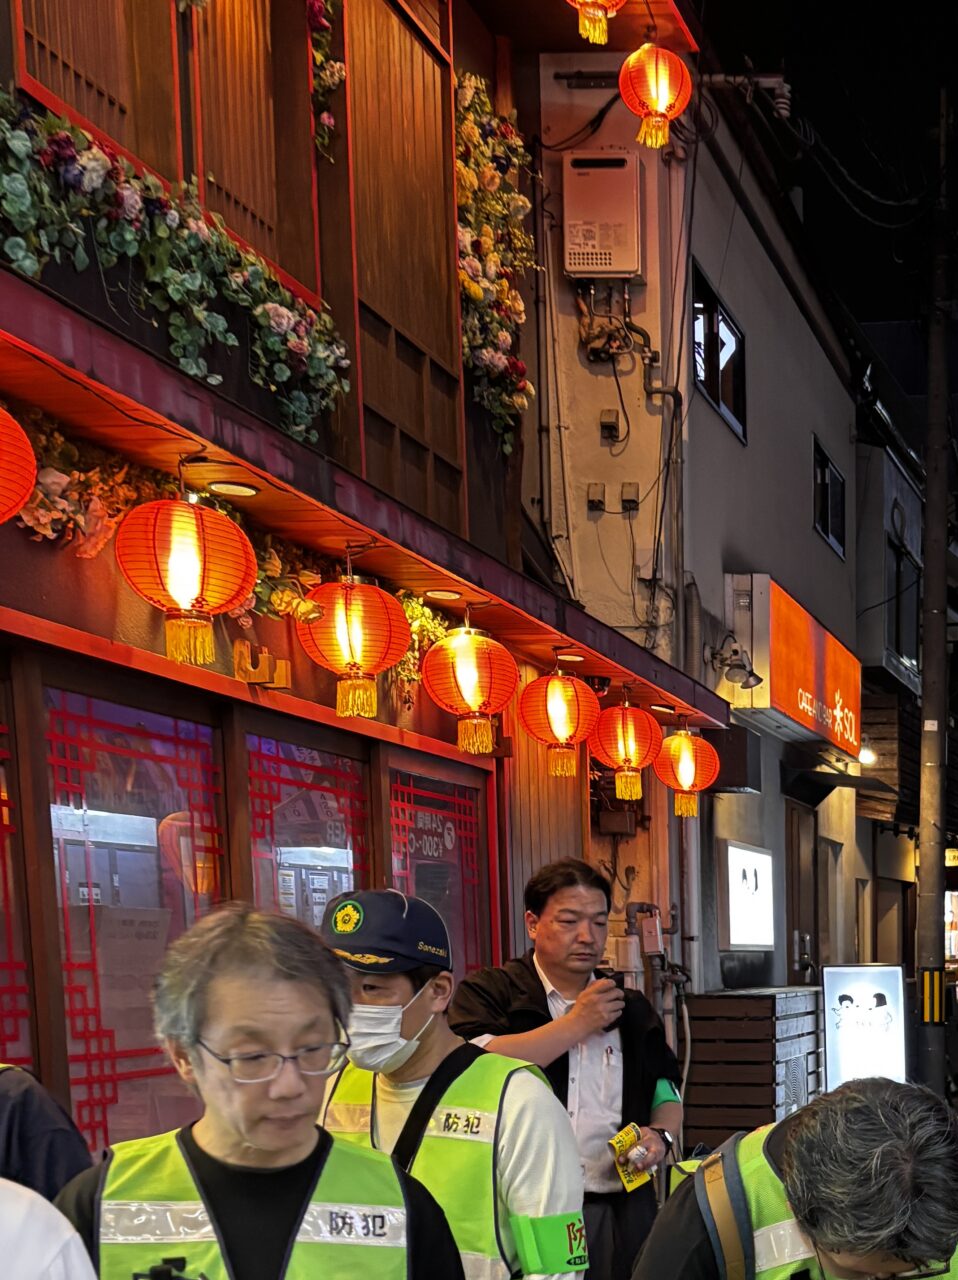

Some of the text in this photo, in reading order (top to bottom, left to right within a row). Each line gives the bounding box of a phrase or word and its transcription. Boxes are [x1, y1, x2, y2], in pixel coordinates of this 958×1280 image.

[843, 707, 858, 746] SOL
[442, 1112, 482, 1135] 防犯
[329, 1211, 388, 1238] 防犯
